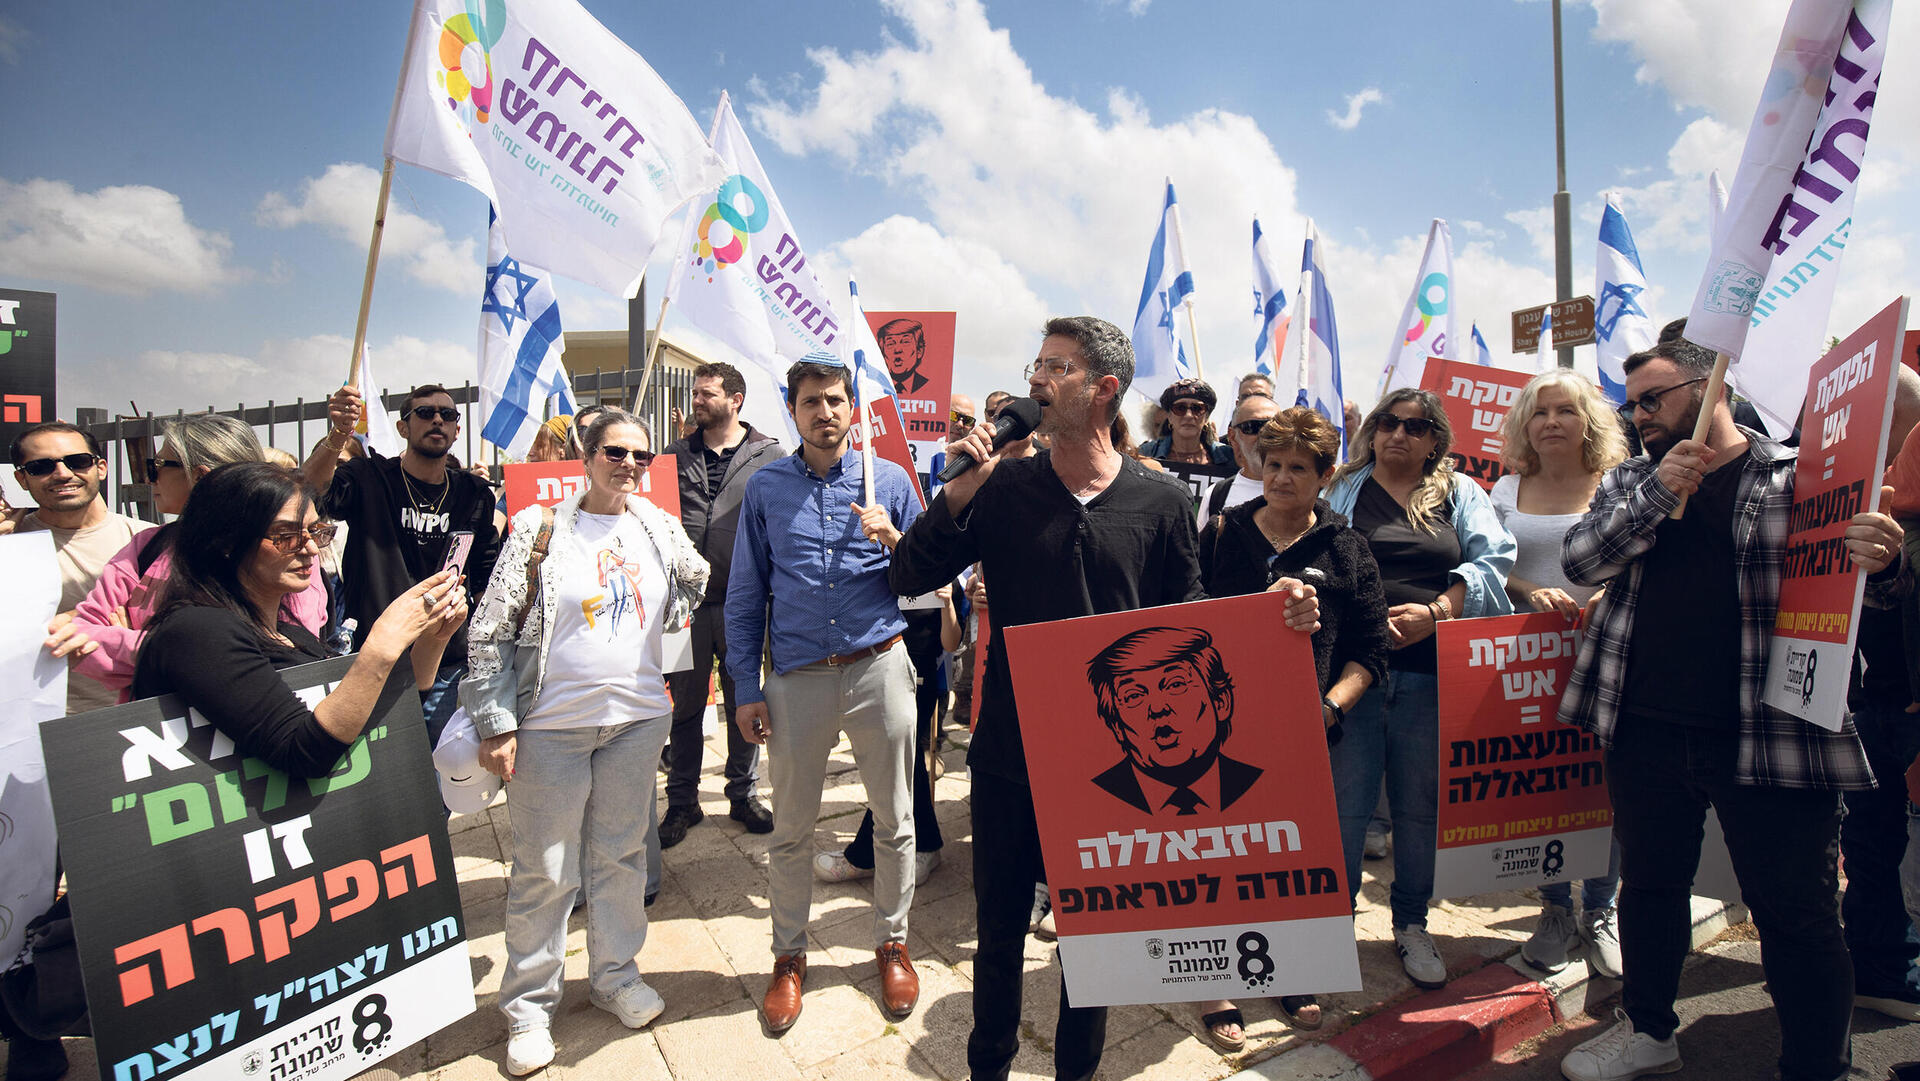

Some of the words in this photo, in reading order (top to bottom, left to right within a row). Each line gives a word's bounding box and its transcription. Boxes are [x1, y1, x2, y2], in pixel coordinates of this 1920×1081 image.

[1552, 307, 1561, 318] ש
[1565, 302, 1584, 315] בית
[1446, 375, 1522, 407] סקת
[1813, 339, 1878, 414] הפסקת
[909, 420, 946, 432] מודה
[1471, 408, 1504, 434] ש
[1821, 402, 1852, 451] אש
[1790, 479, 1865, 535] התעצמות
[1469, 629, 1583, 671] הפסקת
[1501, 668, 1557, 701] אש
[1449, 727, 1601, 768] התעצמות
[1448, 760, 1604, 804] חיזבאללה
[1443, 823, 1499, 843] מוחלט
[1503, 815, 1553, 839] ניצחון
[1557, 809, 1609, 828] חייבים
[243, 813, 314, 884] זו
[1077, 819, 1302, 870] חיזבאללה
[1503, 846, 1541, 860] קריית
[1502, 857, 1540, 872] שמונה
[1058, 872, 1222, 914] לטראמפ
[1236, 867, 1339, 900] מודה
[113, 833, 438, 1008] הפקרה
[401, 915, 459, 960] תנו
[1168, 939, 1227, 956] קריית
[1161, 976, 1196, 984] הזדמנויות
[1168, 957, 1230, 973] שמונה
[1197, 974, 1209, 982] של
[1211, 973, 1232, 981] מרחב
[112, 1009, 241, 1081] לנצח
[270, 1016, 341, 1063] קריית
[269, 1034, 344, 1081] שמונה
[305, 1065, 320, 1077] של
[322, 1052, 346, 1069] מרחב
